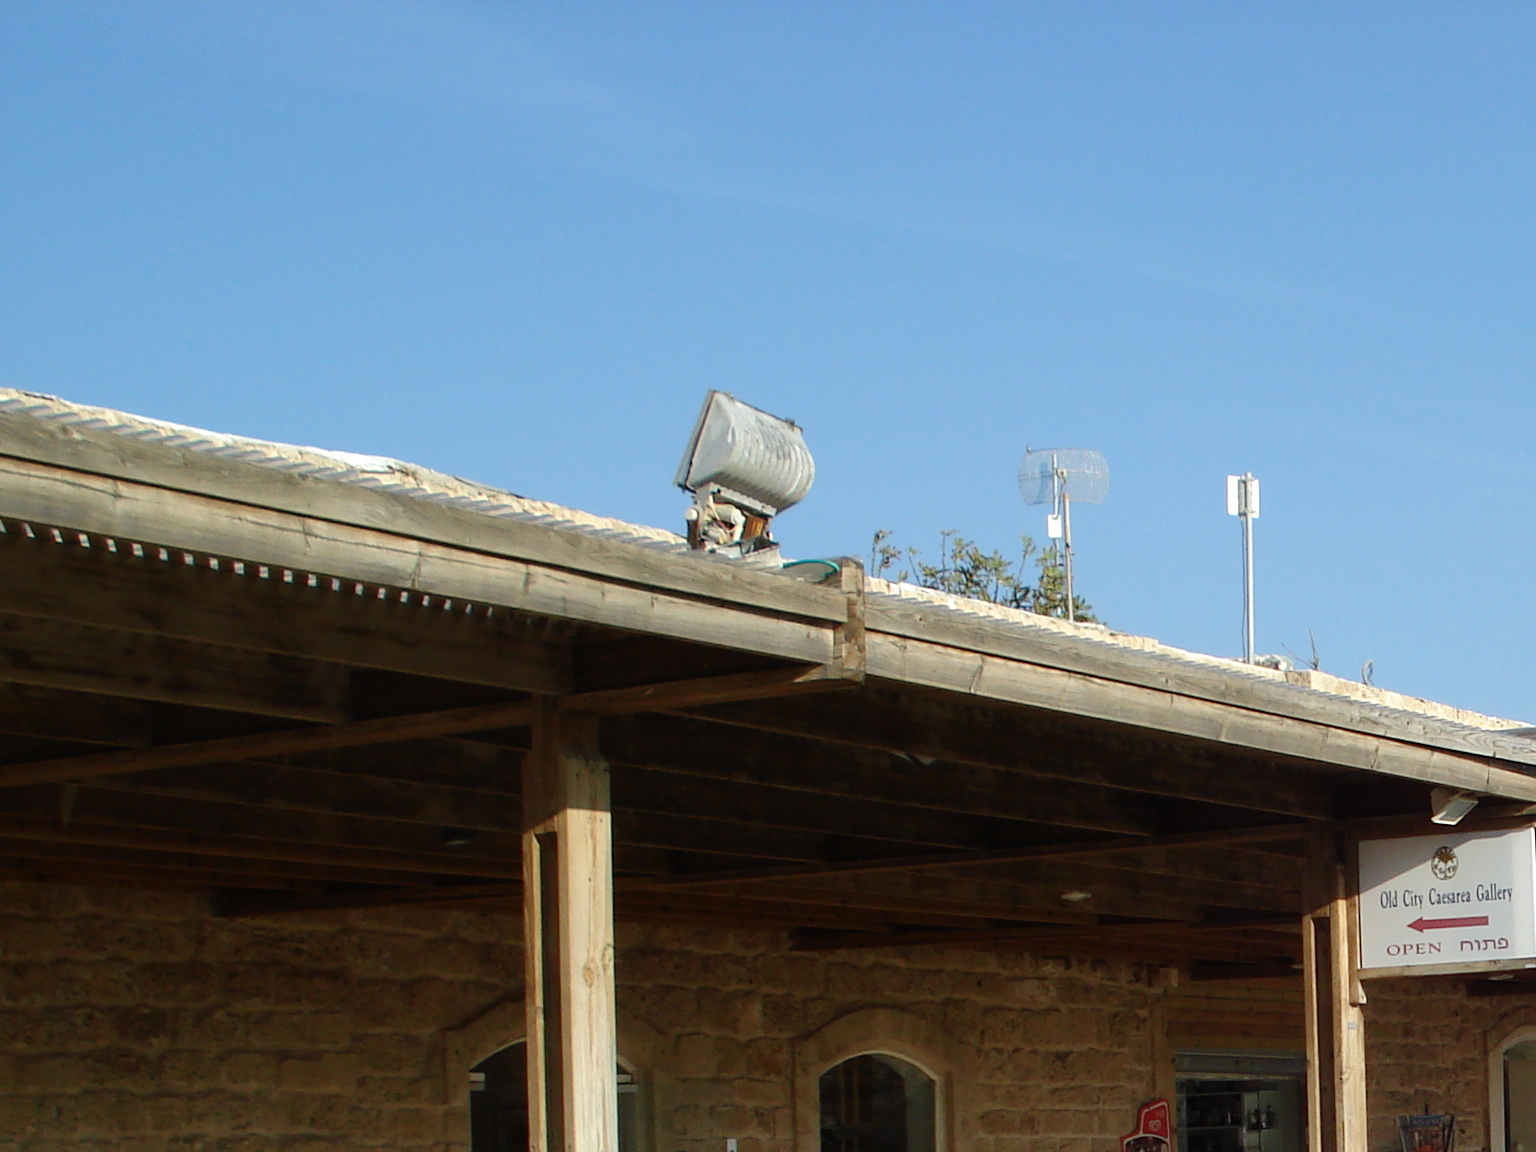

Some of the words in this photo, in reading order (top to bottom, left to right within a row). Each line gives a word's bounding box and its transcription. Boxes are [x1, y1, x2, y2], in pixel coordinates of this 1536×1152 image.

[1380, 890, 1398, 909] Old
[1402, 889, 1424, 909] City
[1428, 887, 1472, 906] Caesarea
[1476, 883, 1513, 902] Gallery
[1386, 942, 1442, 957] OPEN
[1460, 937, 1509, 952] פתוח
